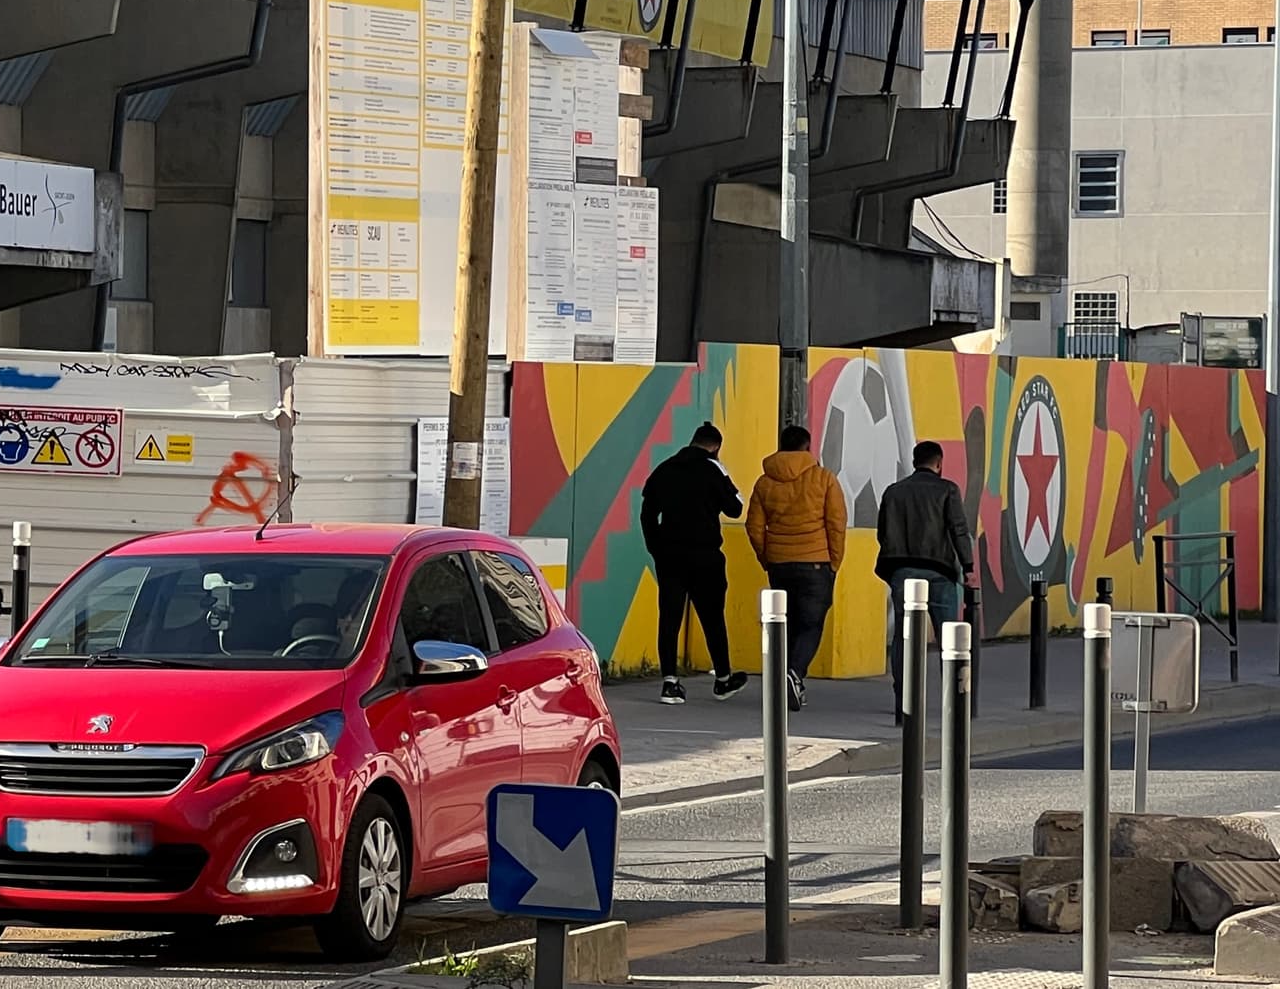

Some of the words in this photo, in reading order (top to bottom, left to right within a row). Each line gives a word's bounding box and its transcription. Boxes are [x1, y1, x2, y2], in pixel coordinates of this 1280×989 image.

[0, 184, 38, 217] Bauer
[368, 225, 381, 241] SCAU
[1032, 381, 1049, 401] STAR
[72, 413, 85, 422] AU
[71, 743, 120, 752] PEUGEOT
